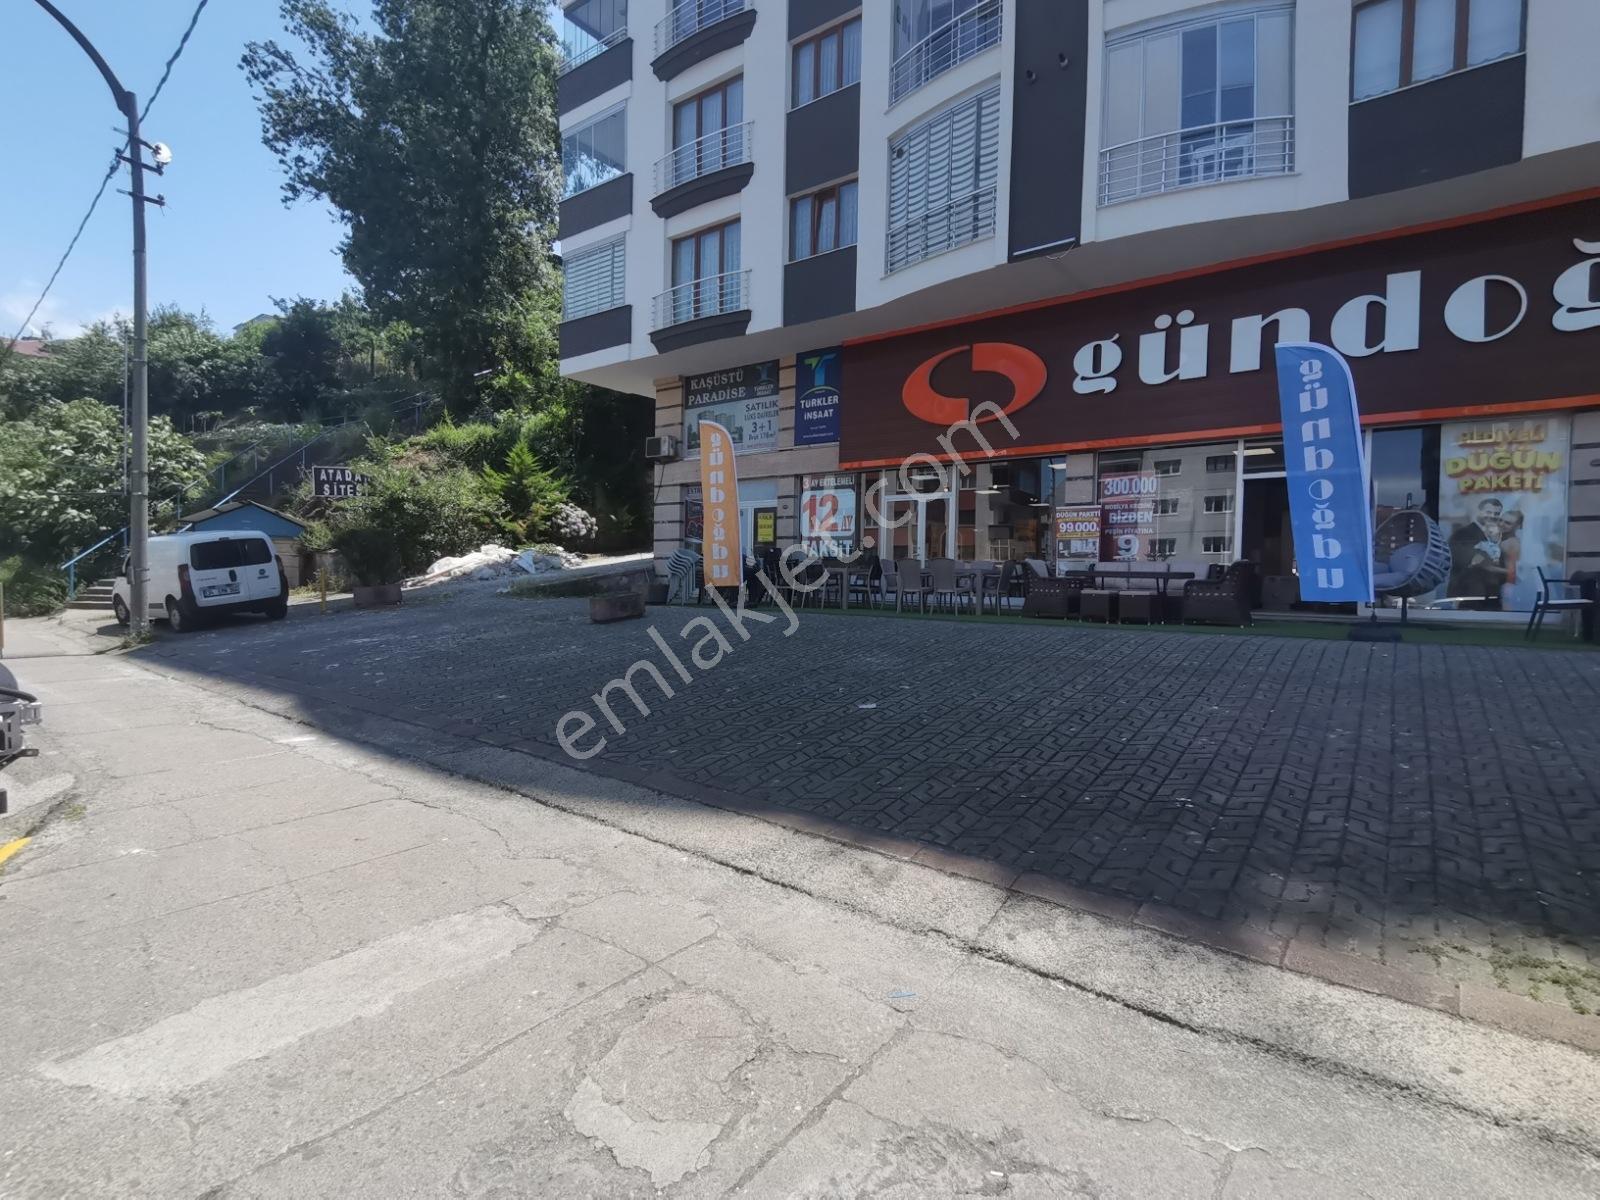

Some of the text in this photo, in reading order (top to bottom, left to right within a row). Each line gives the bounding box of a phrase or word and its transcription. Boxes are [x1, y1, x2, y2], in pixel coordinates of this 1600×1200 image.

[690, 369, 744, 391] KAŞÜSTÜ
[745, 399, 779, 413] SATILIK
[751, 420, 773, 434] 3+1
[1446, 447, 1562, 477] DÜĞÜN
[803, 479, 810, 489] 3
[1104, 477, 1157, 495] 300.000
[802, 493, 839, 533] 12
[1109, 510, 1154, 524] BİZDEN
[1118, 534, 1140, 557] 9
